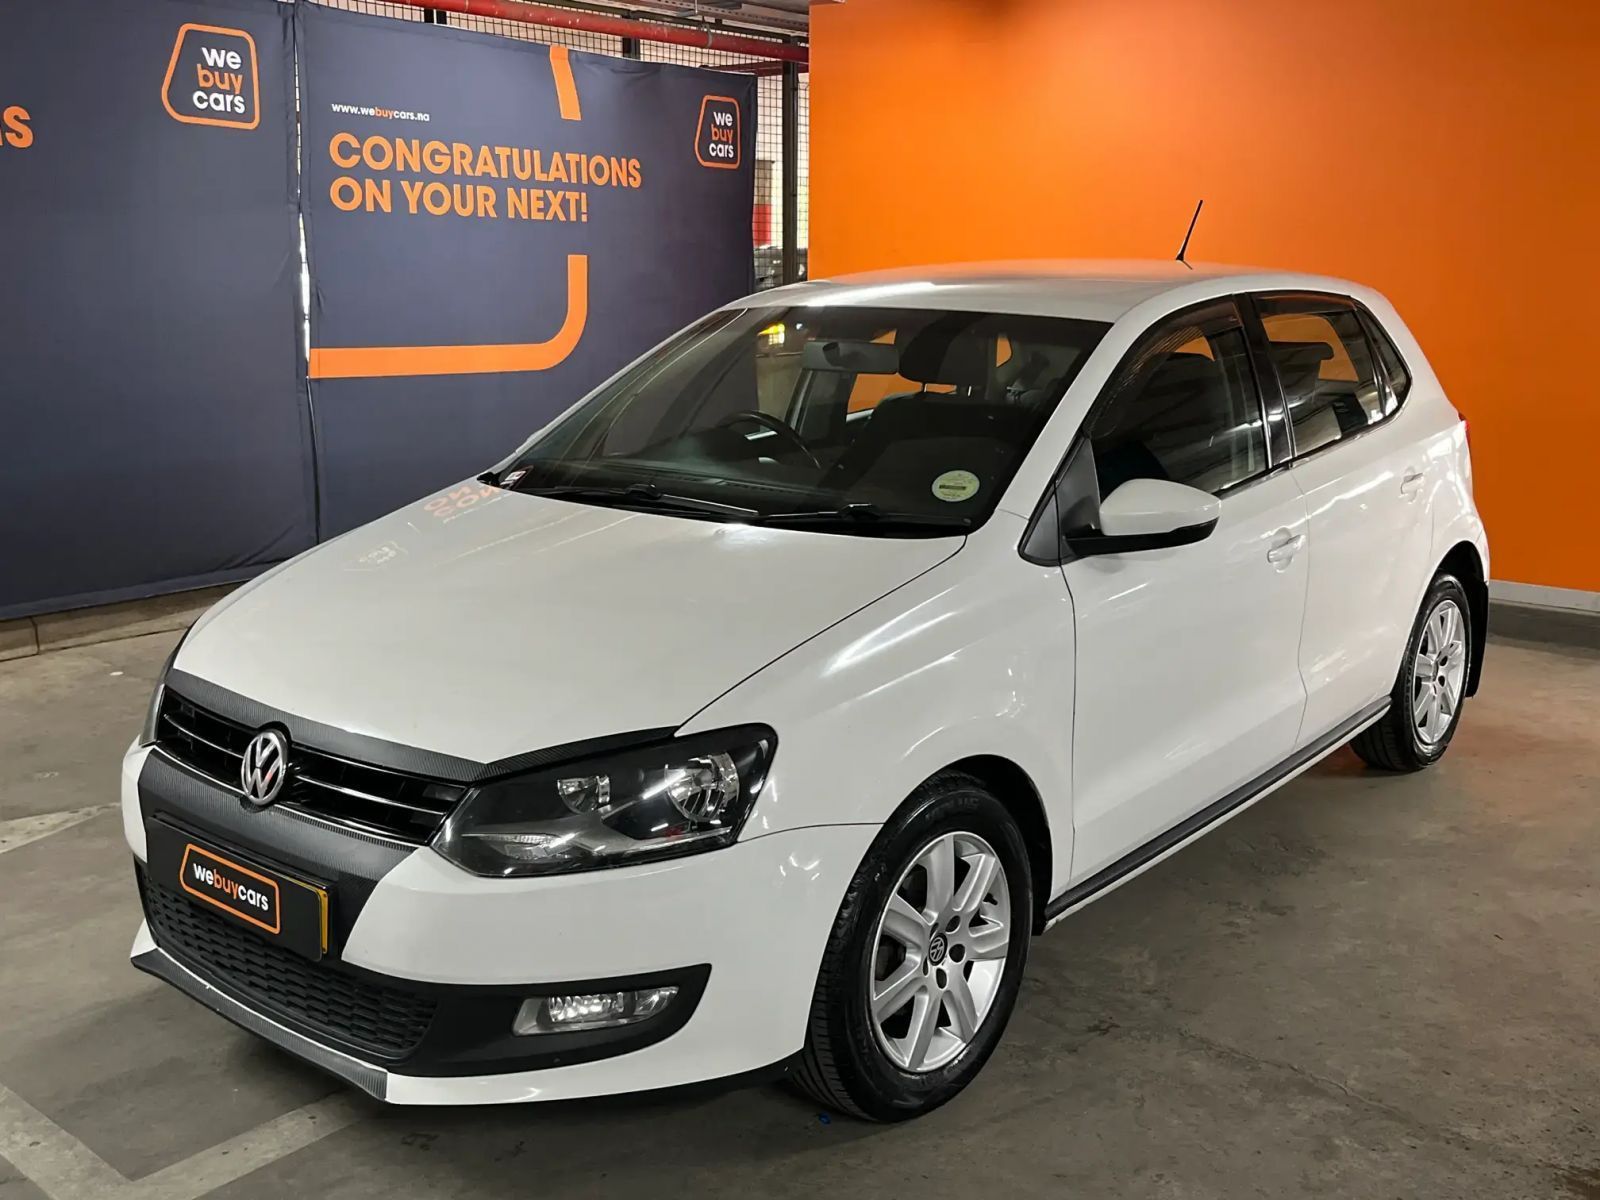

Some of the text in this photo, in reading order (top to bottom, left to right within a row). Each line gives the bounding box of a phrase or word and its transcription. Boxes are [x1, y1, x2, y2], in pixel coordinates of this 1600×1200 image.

[201, 46, 242, 70] we
[196, 64, 243, 94] buy
[192, 90, 246, 114] cars
[331, 103, 430, 122] www.webuycars.na
[0, 105, 34, 149] S
[713, 111, 733, 127] we
[710, 123, 734, 144] buy
[328, 132, 642, 188] CONGRATULATIONS
[708, 142, 735, 158] cars
[329, 175, 588, 222] ON YOUR NEXT!
[193, 862, 270, 912] webuycars
